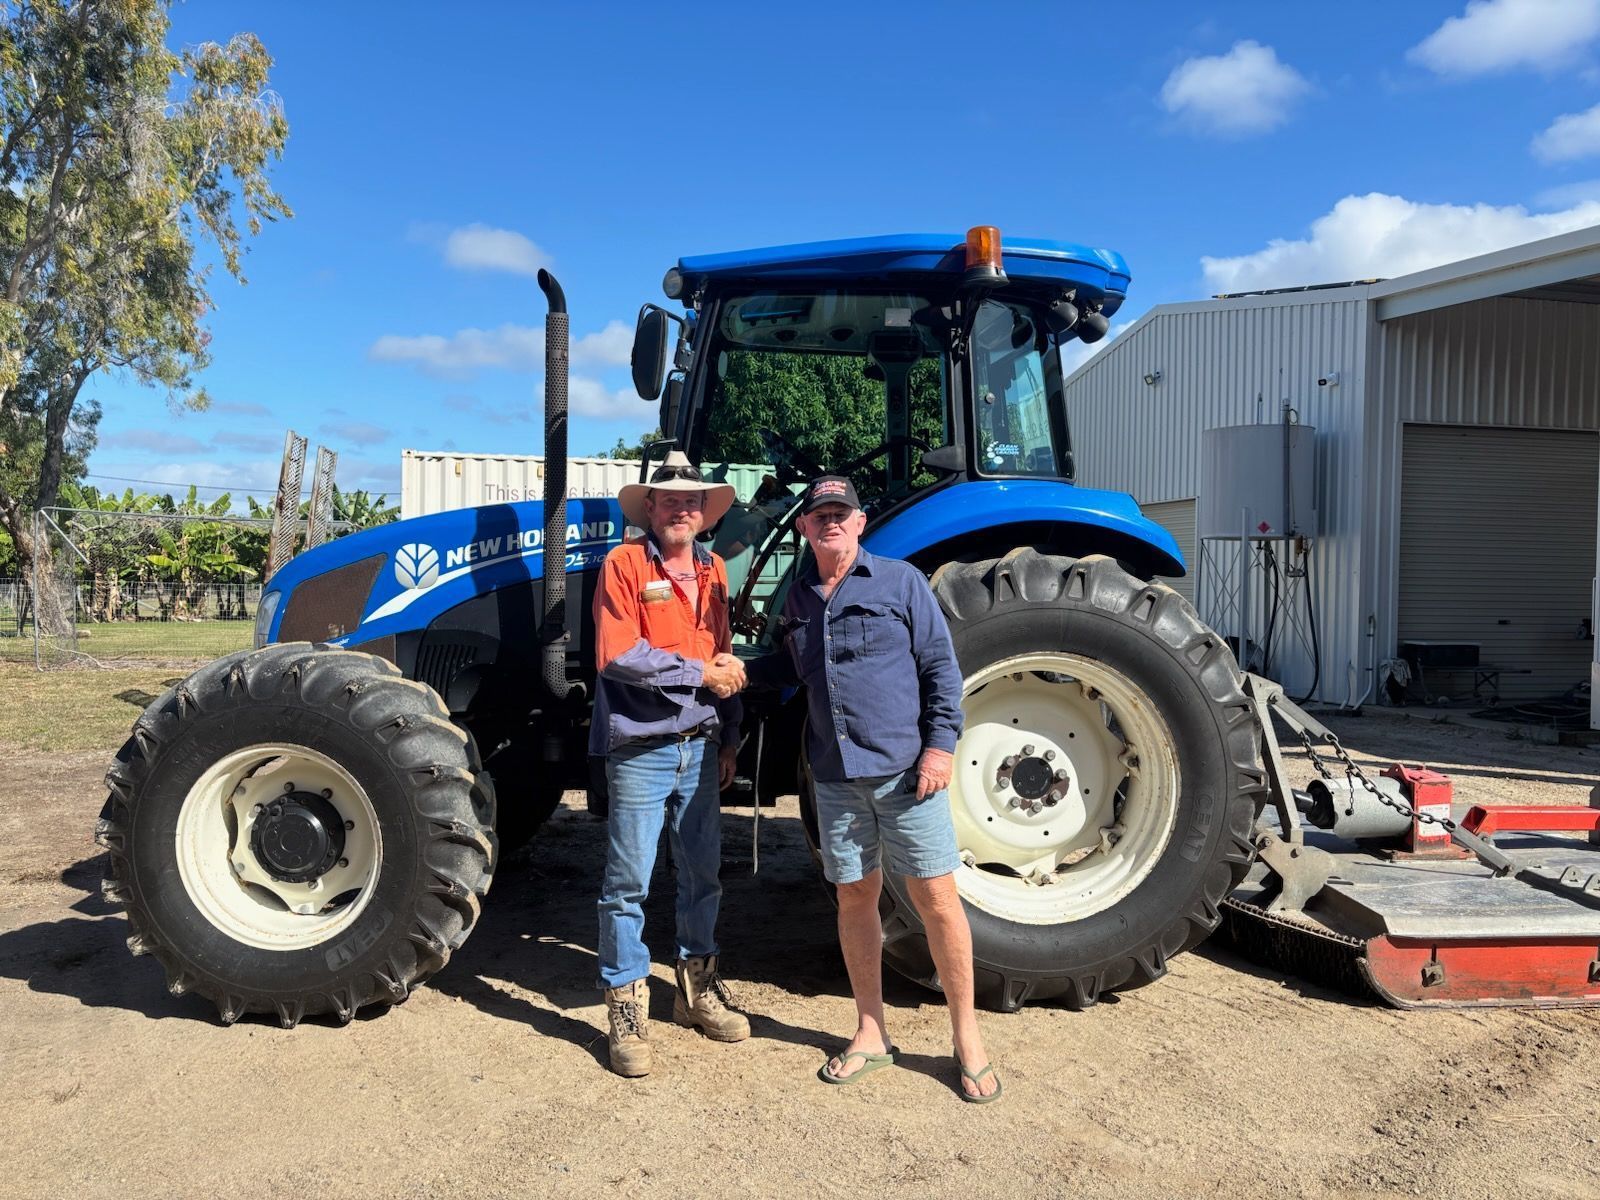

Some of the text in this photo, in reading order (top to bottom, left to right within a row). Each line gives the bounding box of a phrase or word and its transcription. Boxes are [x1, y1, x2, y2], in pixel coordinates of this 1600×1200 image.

[485, 484, 519, 501] This
[524, 486, 536, 502] is
[446, 521, 615, 567] NEW HOAND
[1184, 794, 1213, 856] CEAT
[337, 913, 386, 966] CEAT
